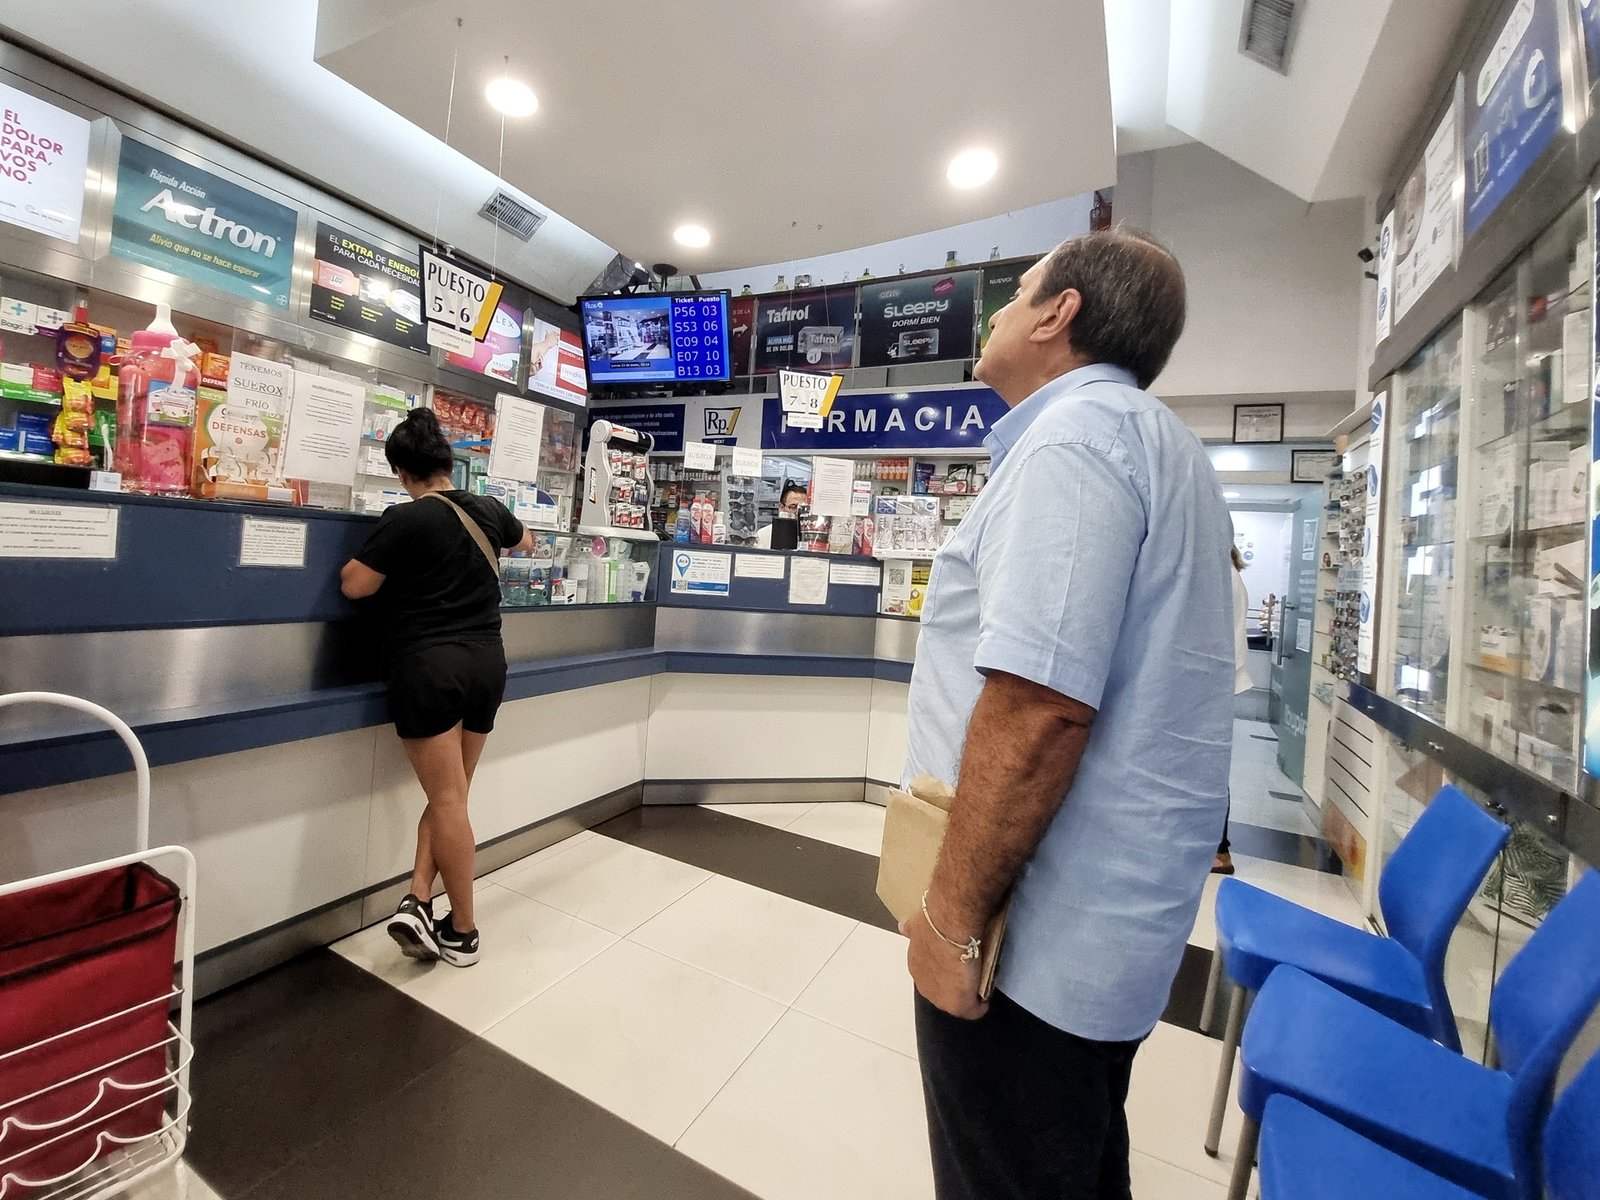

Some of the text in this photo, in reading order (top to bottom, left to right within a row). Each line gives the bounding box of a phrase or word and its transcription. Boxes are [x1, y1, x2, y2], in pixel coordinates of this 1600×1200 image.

[4, 109, 21, 125] EL
[2, 122, 63, 156] DOLOR
[0, 136, 53, 167] PARA,
[0, 149, 37, 172] VOS
[0, 163, 32, 185] NO.
[150, 168, 206, 199] Rápida Acción
[140, 188, 277, 258] Actron
[150, 233, 261, 279] Alivio que no se hace esperar
[329, 234, 420, 279] EL EXTRA DE ENERGÍ
[333, 245, 356, 260] PARA
[357, 255, 380, 270] CADA
[427, 262, 485, 302] PUESTO
[432, 295, 444, 313] 5
[459, 306, 471, 323] 6
[674, 305, 717, 317] P56 03
[767, 305, 811, 323] Tafirol
[675, 321, 718, 332] S53 06
[920, 315, 940, 325] BIEN
[676, 336, 718, 347] C09 04
[810, 334, 838, 344] Tafirol
[677, 351, 719, 361] E07 10
[240, 361, 283, 378] TENEMOS
[678, 366, 700, 376] B13
[706, 365, 720, 375] 03
[234, 377, 284, 396] SUEROX
[783, 374, 828, 390] PUESTO
[200, 390, 223, 400] NUEVO
[245, 398, 269, 410] FRÍO
[790, 396, 797, 406] 7
[810, 398, 818, 408] 8
[781, 405, 985, 433] RMACIA
[212, 421, 266, 439] DEFENSAS
